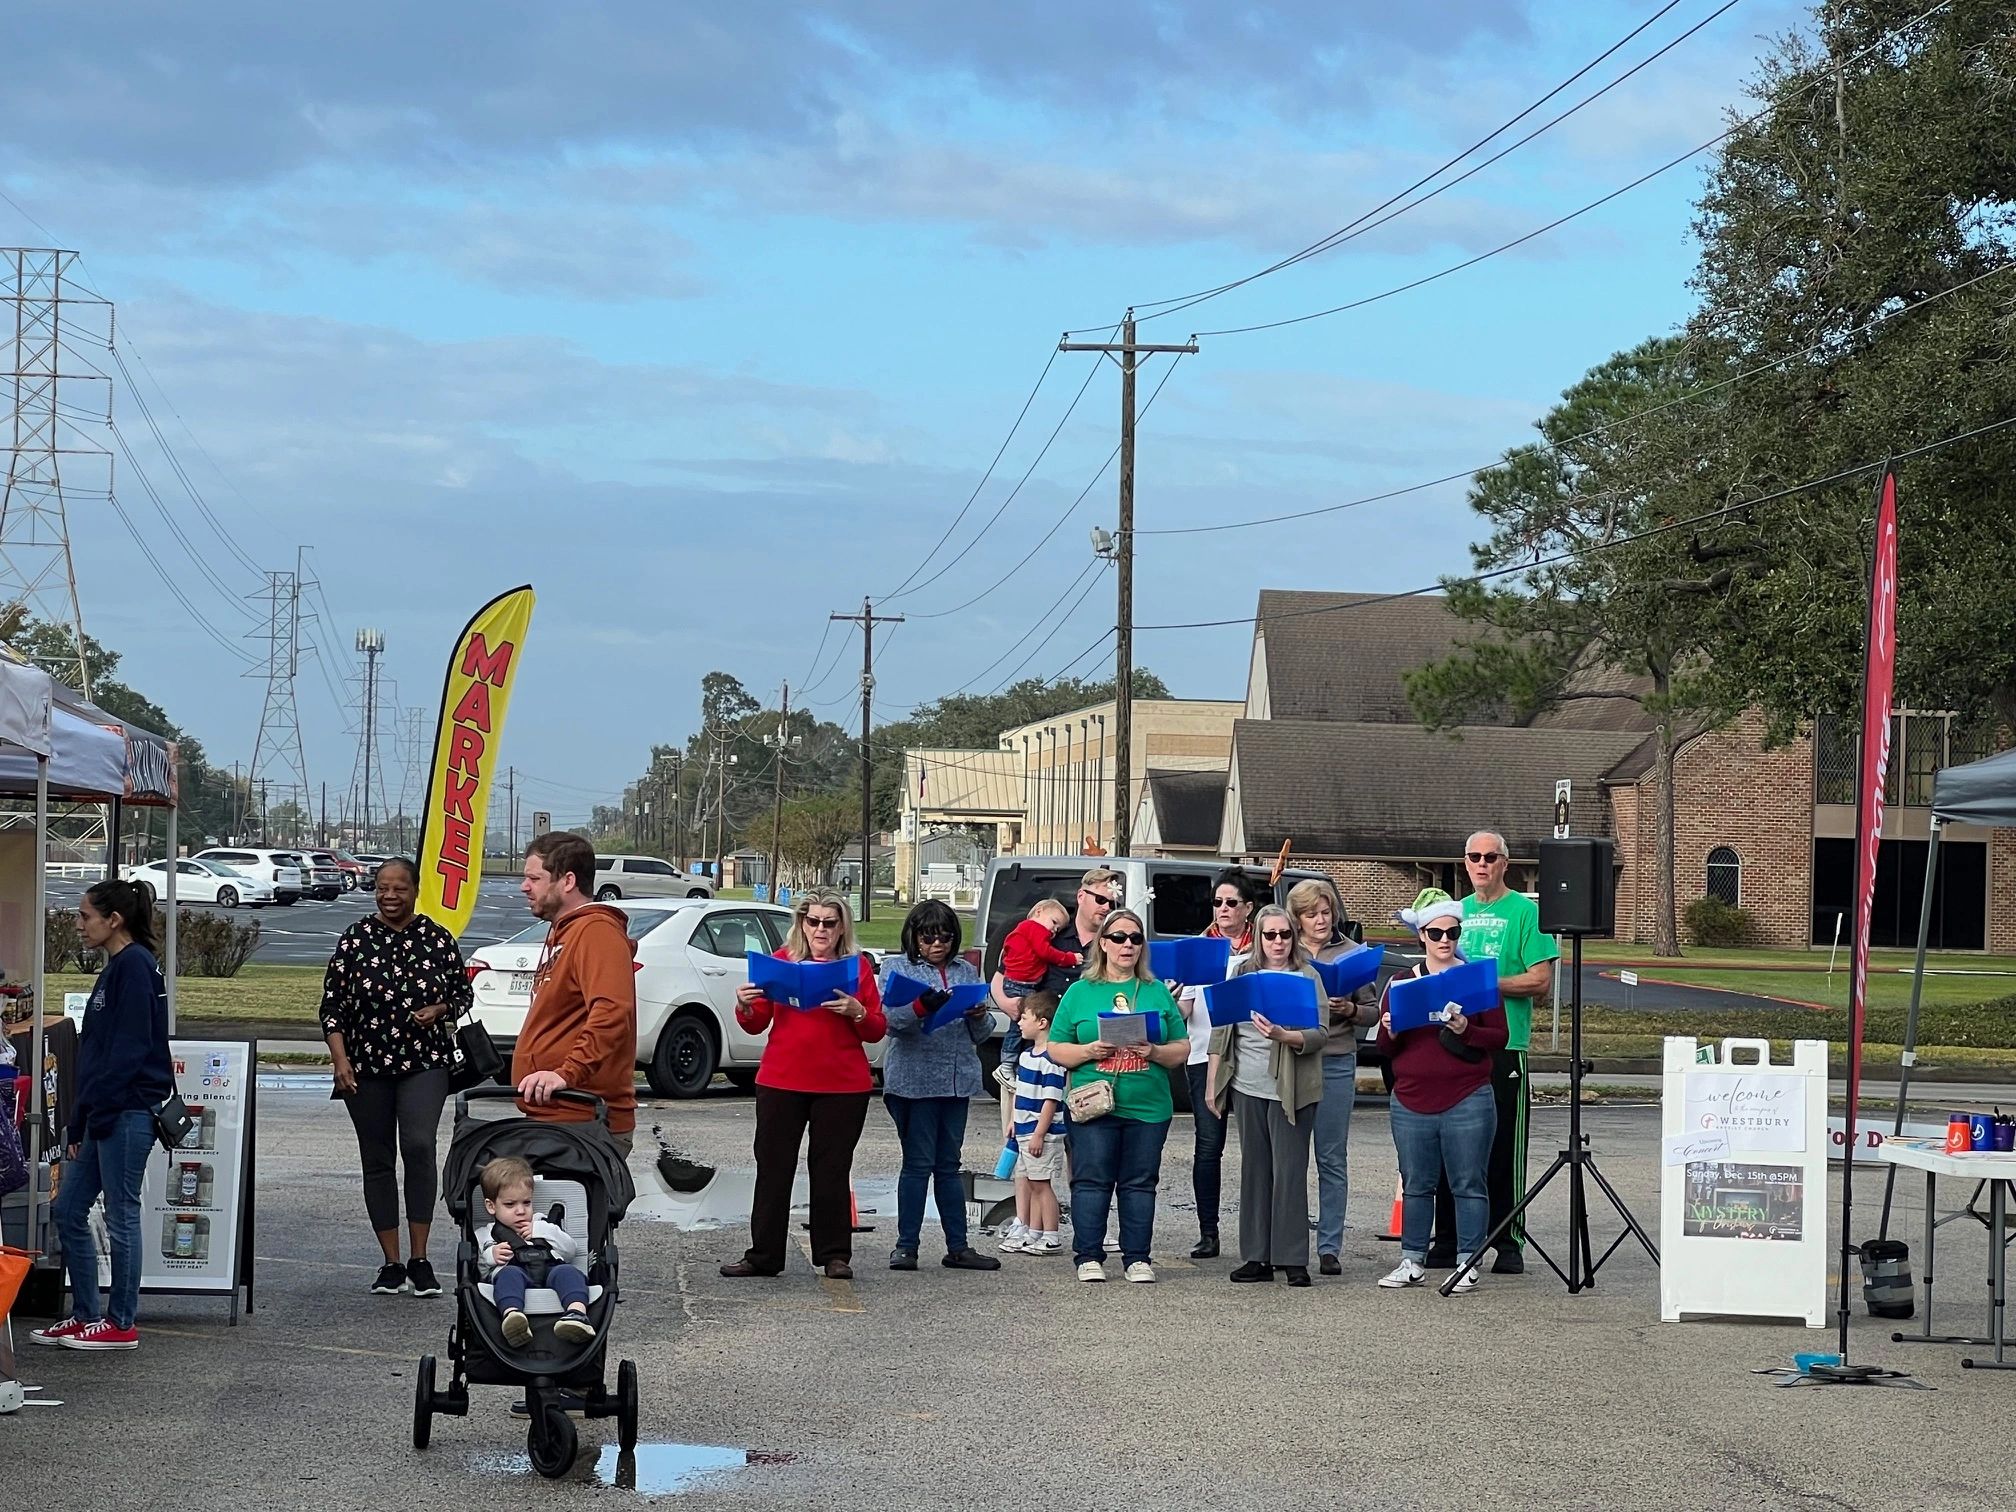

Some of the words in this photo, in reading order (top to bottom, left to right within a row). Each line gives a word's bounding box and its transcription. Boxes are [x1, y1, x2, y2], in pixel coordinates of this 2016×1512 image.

[436, 631, 514, 911] MARKET
[203, 1093, 236, 1101] Blends
[1696, 1078, 1791, 1114] welcome
[1720, 1116, 1790, 1127] WESTBURY
[1725, 1170, 1745, 1180] Dec.
[1747, 1171, 1767, 1180] 15th
